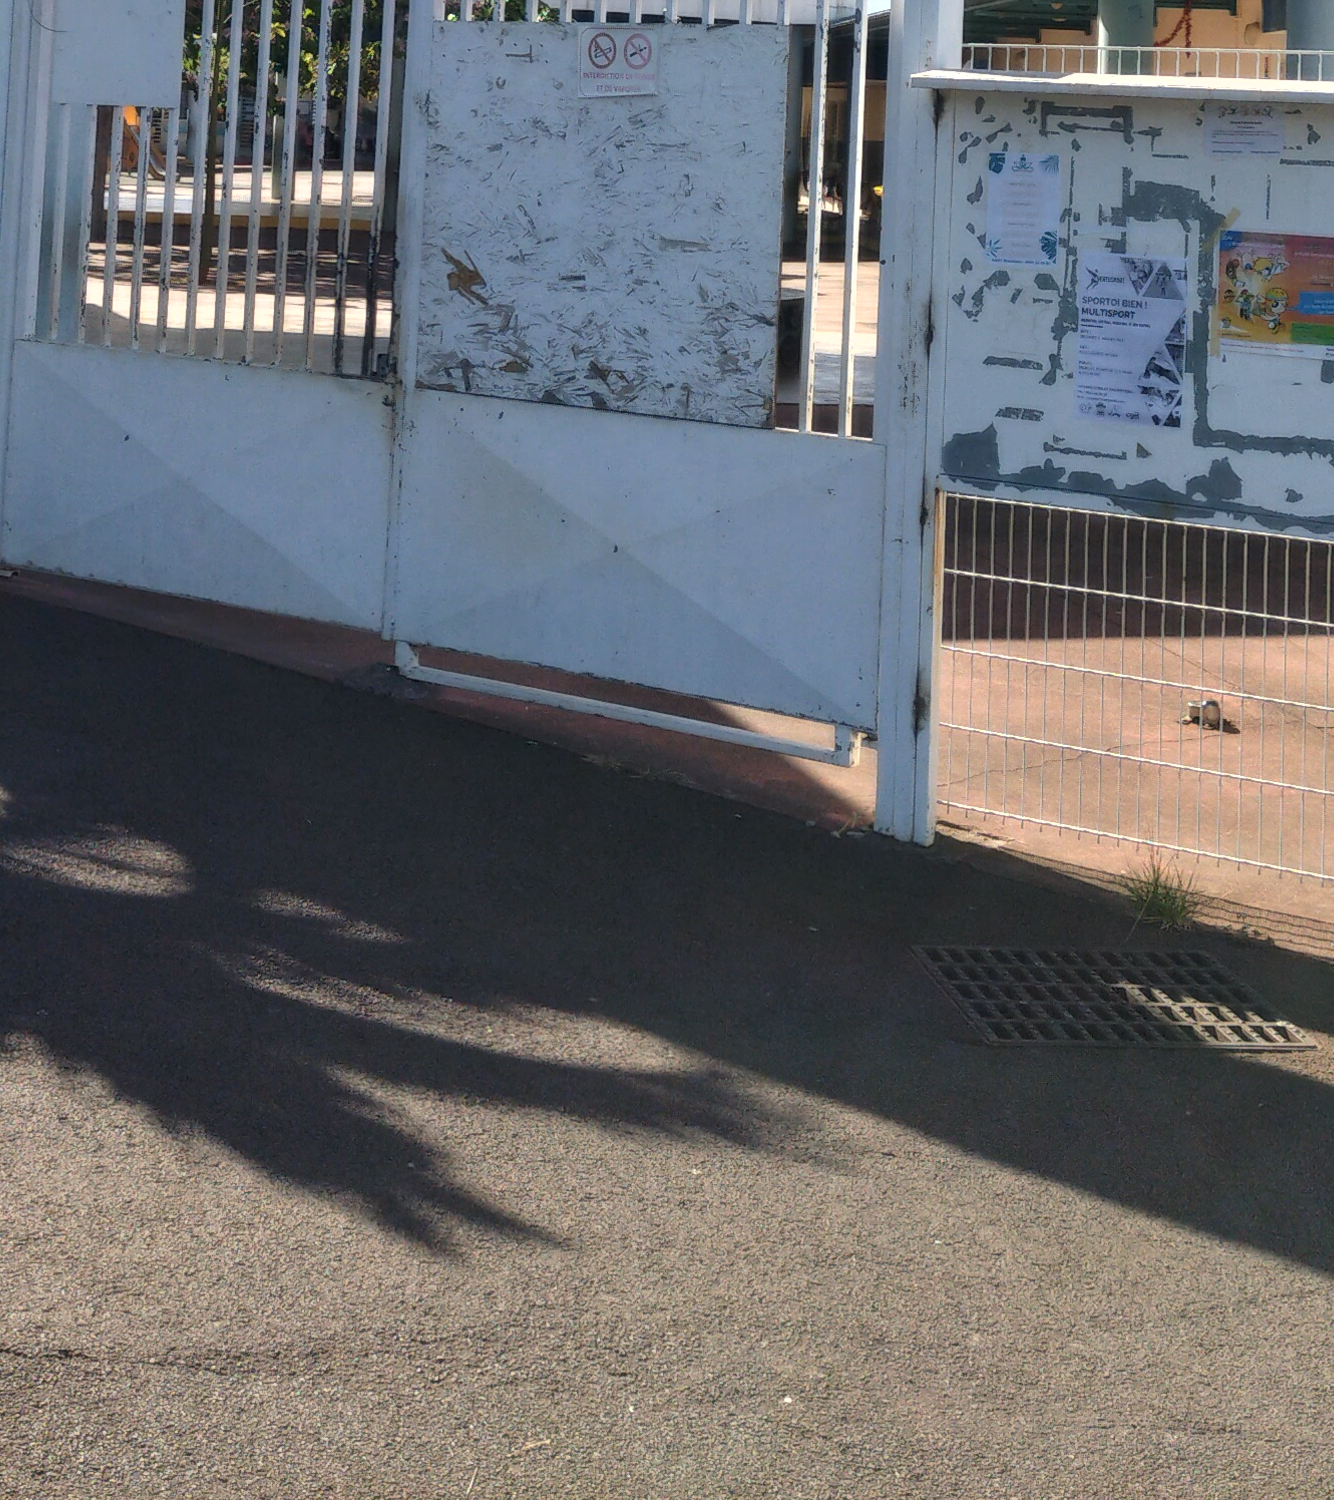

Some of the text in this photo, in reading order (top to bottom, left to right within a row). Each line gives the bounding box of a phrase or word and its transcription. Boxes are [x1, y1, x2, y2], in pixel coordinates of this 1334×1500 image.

[1081, 295, 1120, 307] SPORTOI
[1122, 299, 1143, 309] BIEN
[1081, 307, 1136, 319] MULTISPORT
